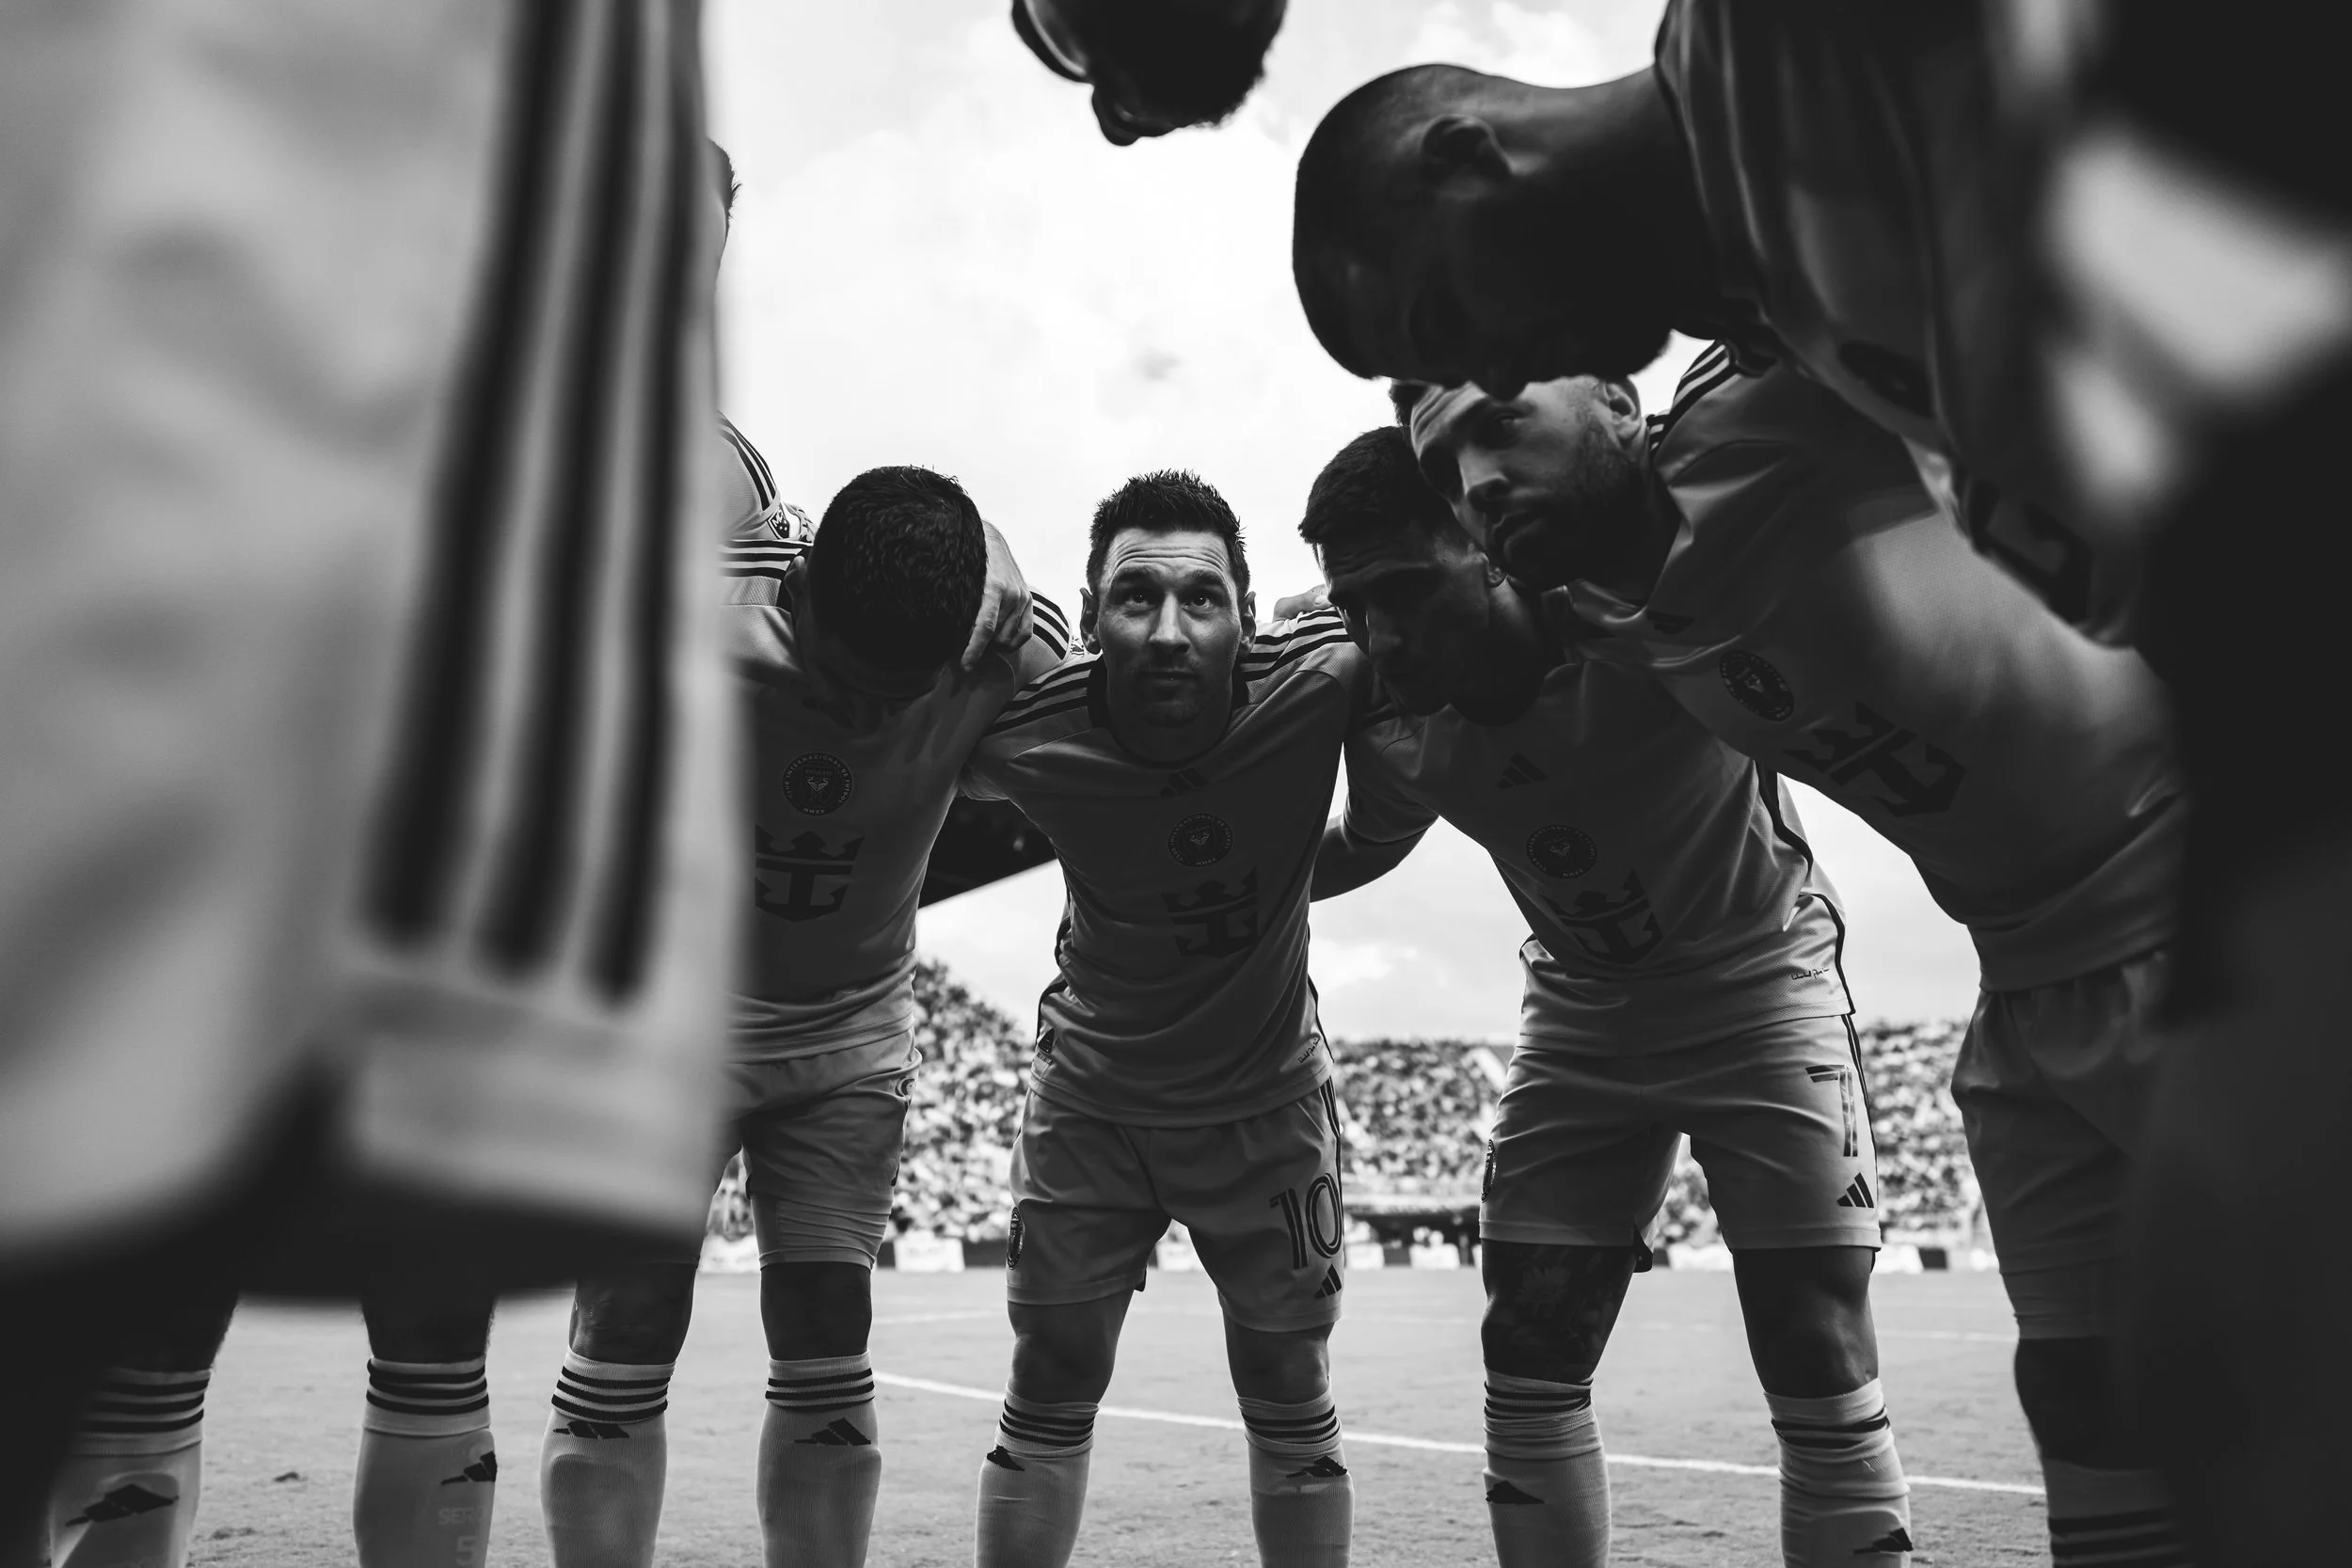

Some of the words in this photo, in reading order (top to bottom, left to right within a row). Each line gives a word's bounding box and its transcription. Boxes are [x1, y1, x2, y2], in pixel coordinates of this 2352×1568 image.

[786, 753, 842, 779] INTERNACIONAL
[1805, 1064, 1858, 1157] 7
[1269, 1173, 1343, 1270] 10
